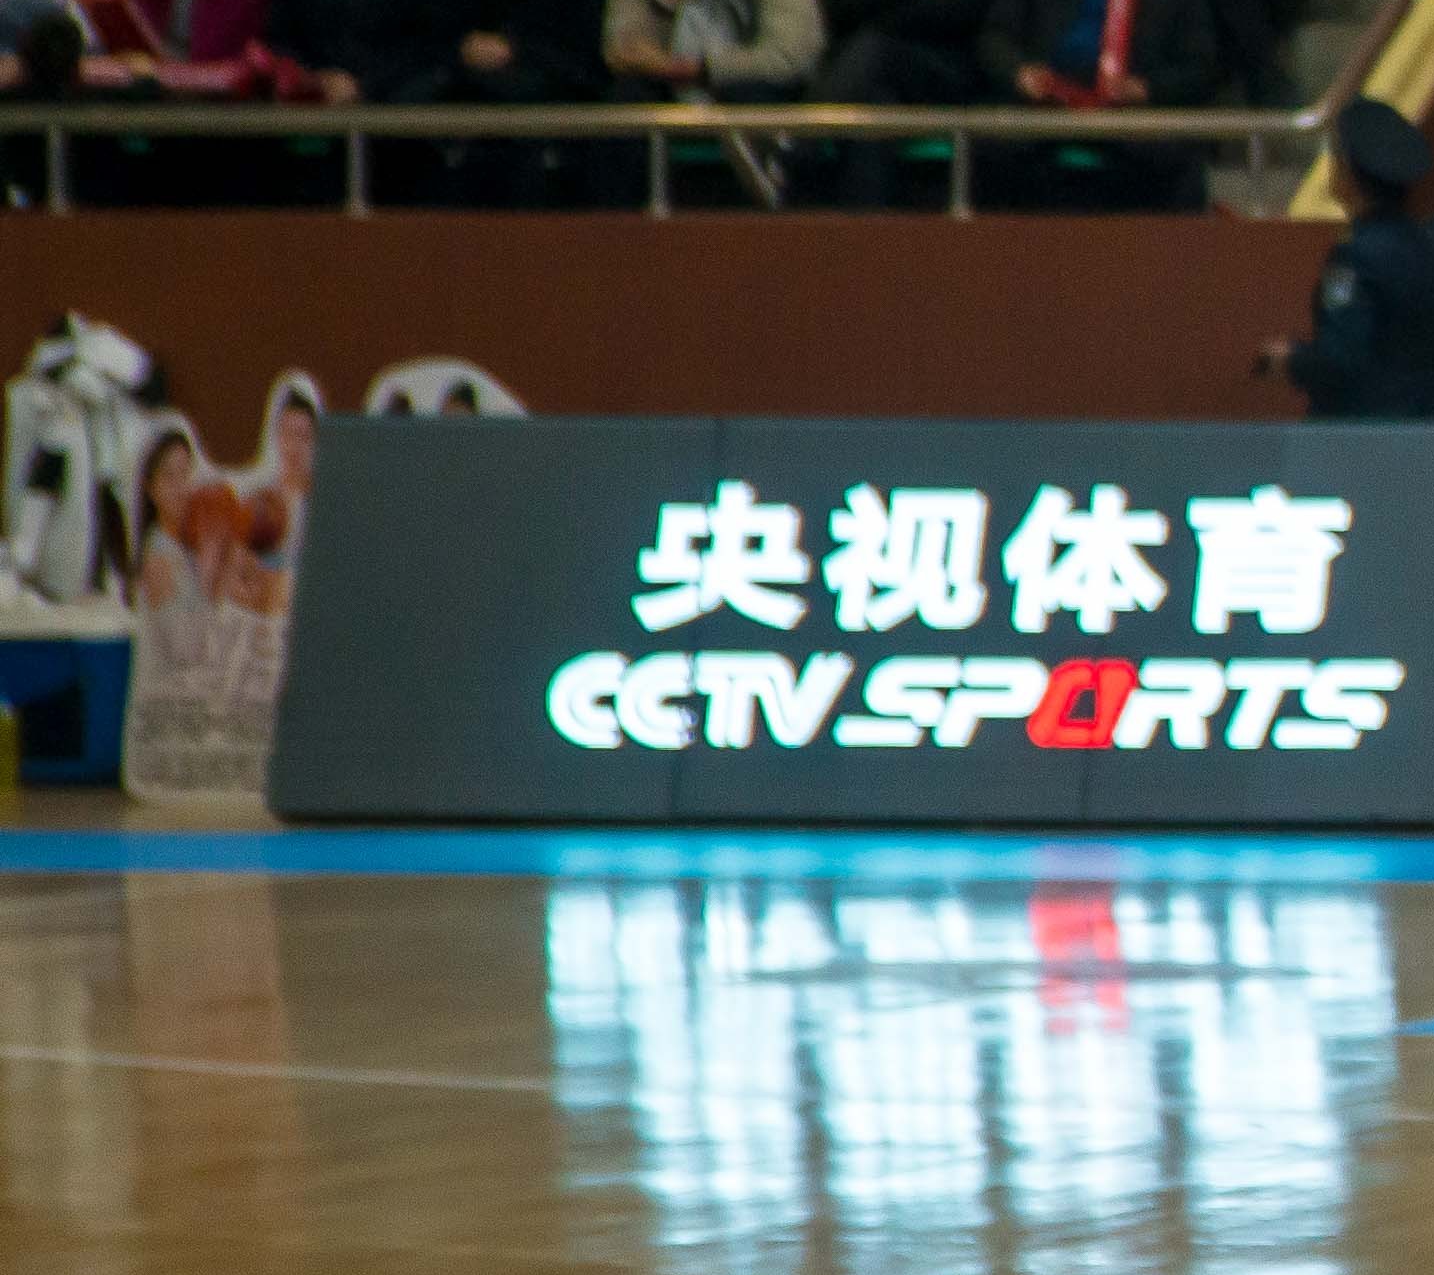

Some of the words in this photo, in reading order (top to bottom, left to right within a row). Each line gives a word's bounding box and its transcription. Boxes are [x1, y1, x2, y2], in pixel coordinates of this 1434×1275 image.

[630, 479, 1353, 635] 央视体育
[547, 650, 857, 750] CCTV
[834, 656, 1406, 751] SPORTS
